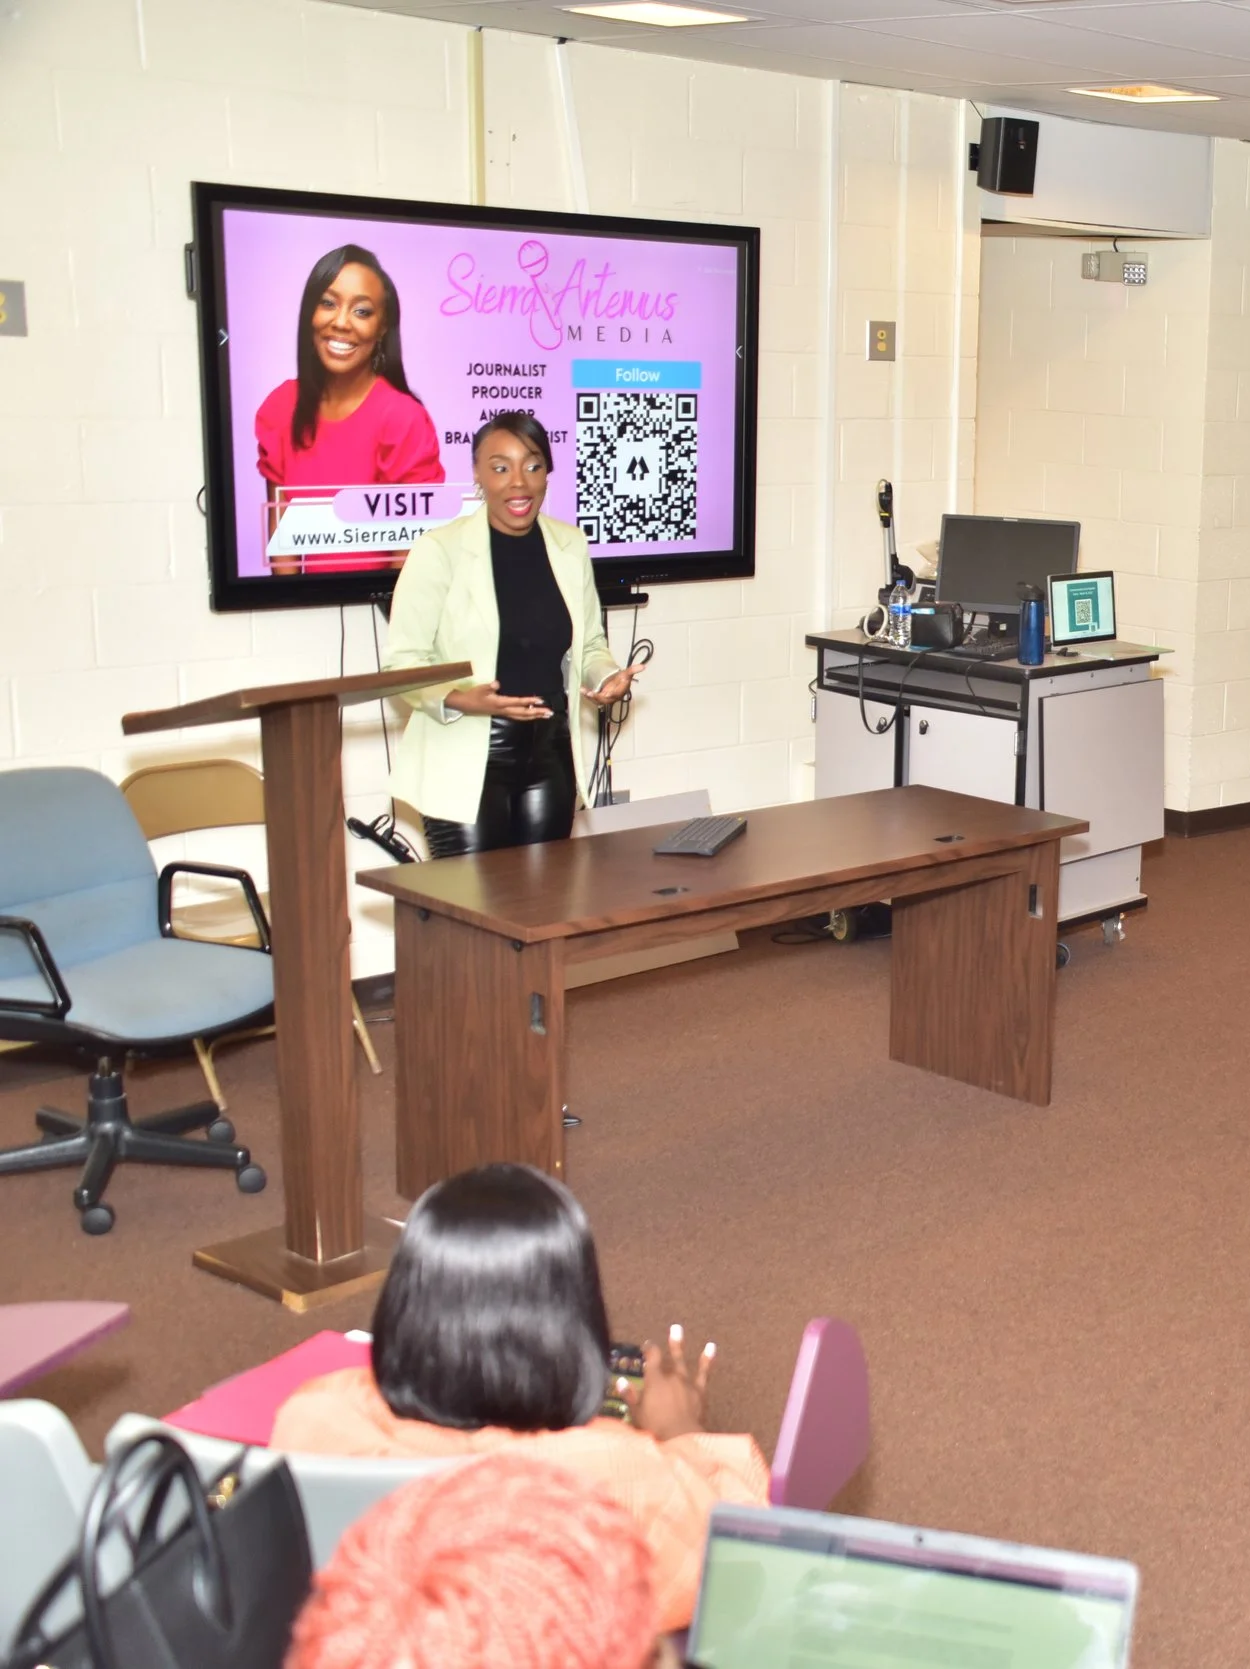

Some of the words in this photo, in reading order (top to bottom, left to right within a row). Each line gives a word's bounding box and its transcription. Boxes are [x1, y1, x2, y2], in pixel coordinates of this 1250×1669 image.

[440, 253, 539, 316] Sierra
[567, 325, 673, 344] MEDIA
[466, 363, 547, 377] JOURNALIST
[615, 368, 661, 382] Follow
[472, 386, 543, 399] PRODUCER
[364, 492, 434, 517] VISIT
[292, 527, 431, 546] www.SierraArt
